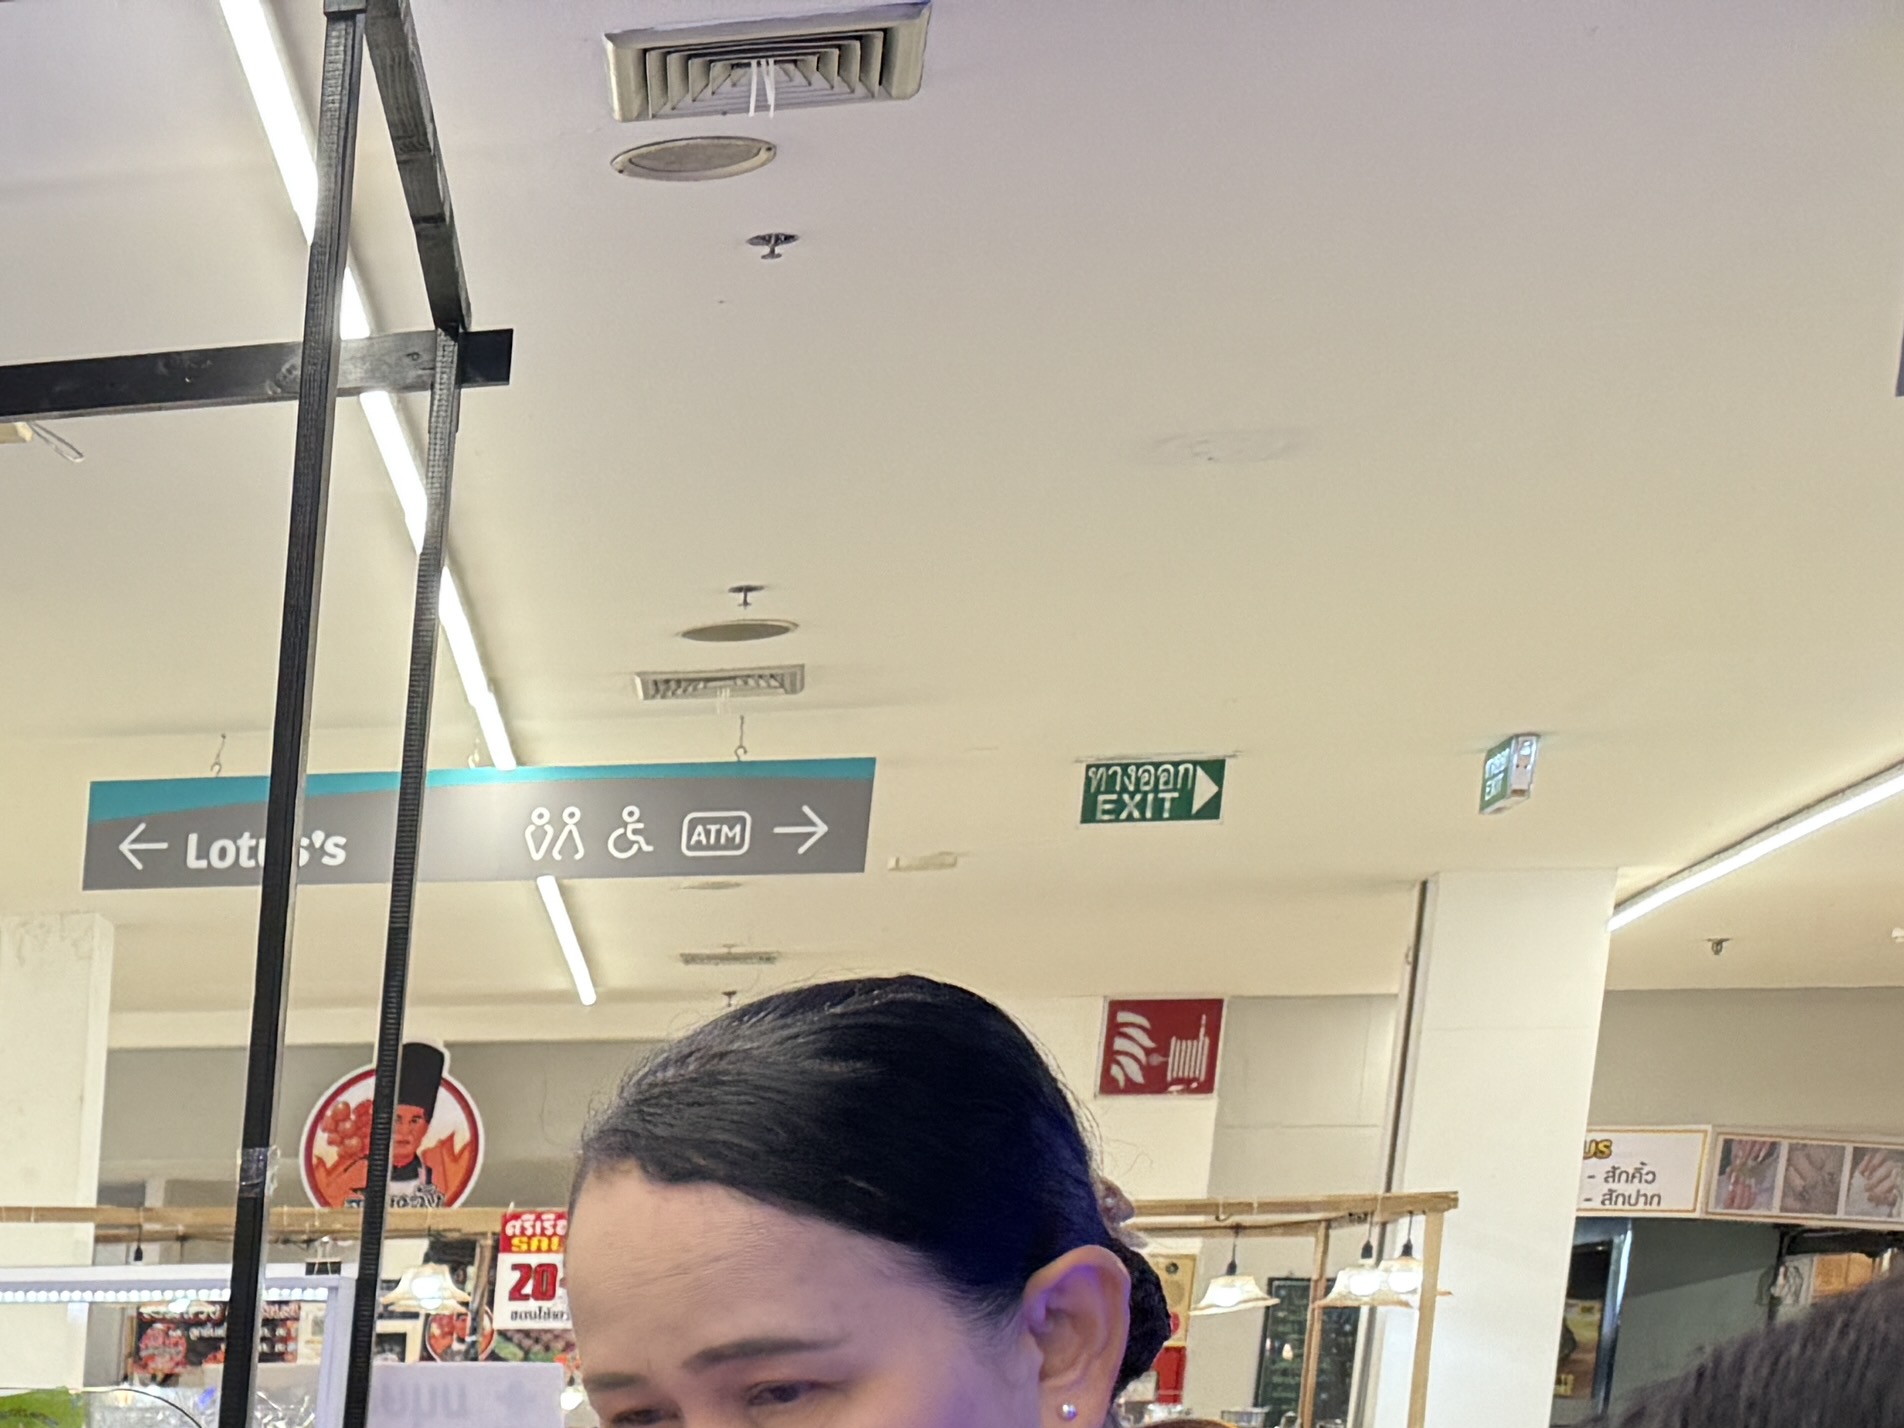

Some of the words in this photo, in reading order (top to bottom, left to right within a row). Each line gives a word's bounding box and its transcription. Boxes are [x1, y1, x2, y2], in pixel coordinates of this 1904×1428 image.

[1088, 763, 1193, 792] ทางออก
[1096, 793, 1179, 820] EXIT
[690, 823, 742, 845] ATM
[186, 831, 347, 870] Lot's
[1604, 1161, 1656, 1184] สักคิ้ว
[1601, 1188, 1662, 1207] สักปาก
